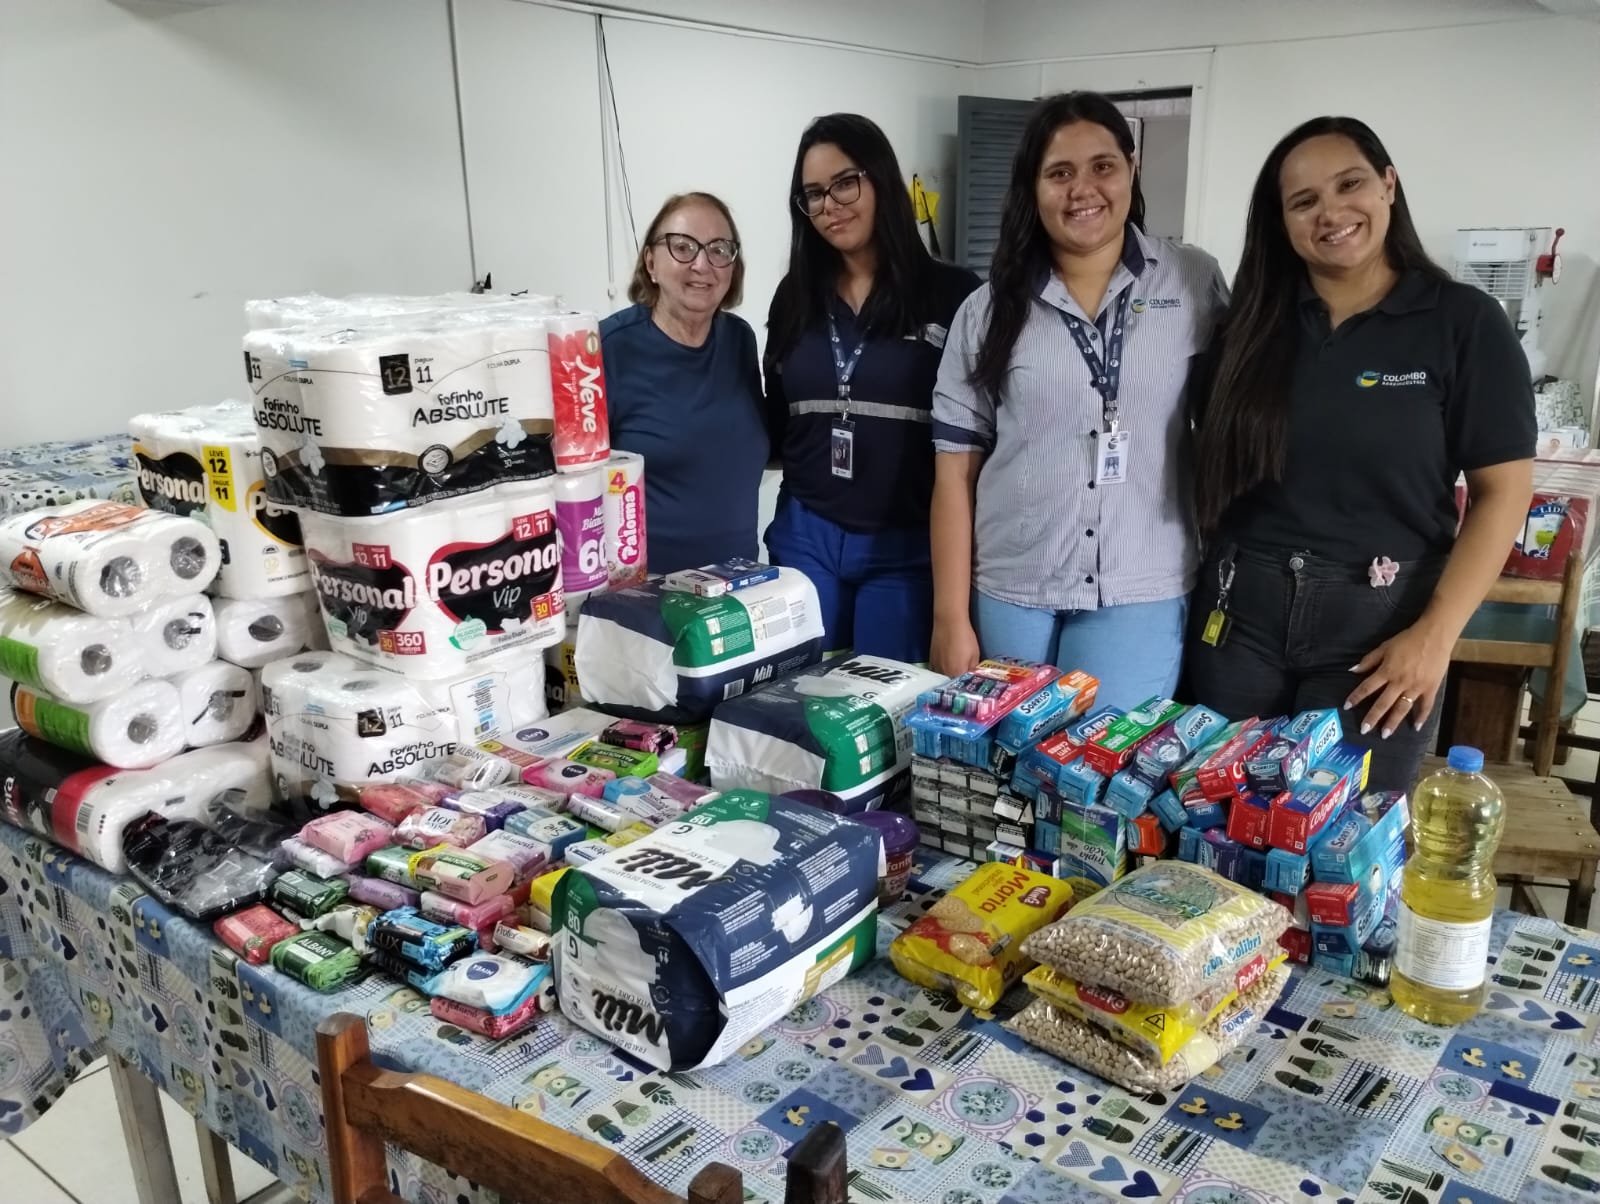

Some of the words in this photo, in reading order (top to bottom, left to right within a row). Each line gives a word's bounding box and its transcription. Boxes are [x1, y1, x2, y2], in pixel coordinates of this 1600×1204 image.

[384, 367, 409, 389] 12
[416, 365, 434, 384] 11
[1383, 371, 1427, 382] COLOMBO
[438, 389, 484, 406] fofinho
[575, 355, 603, 433] Neve
[263, 397, 300, 414] fofinho
[413, 397, 510, 428] ABSOLUTE
[209, 458, 228, 474] 12
[134, 456, 211, 504] Personal
[610, 472, 626, 489] 4
[215, 487, 229, 500] 11
[516, 523, 532, 539] 12
[536, 518, 549, 534] 11
[621, 490, 637, 560] Paloma
[372, 552, 387, 567] 11
[429, 527, 564, 602] Personal
[311, 560, 417, 610] Personal
[536, 603, 549, 617] 30
[396, 633, 422, 646] 360
[752, 664, 773, 684] Mili
[1020, 692, 1050, 715] SORRISO
[390, 713, 404, 728] 11
[1187, 712, 1213, 738] SORRISO
[368, 743, 456, 778] ABSOLUTE
[1311, 790, 1342, 829] Colgate
[978, 871, 1030, 913] Maria
[299, 937, 337, 957] ALBANY
[591, 988, 666, 1048] Mili
